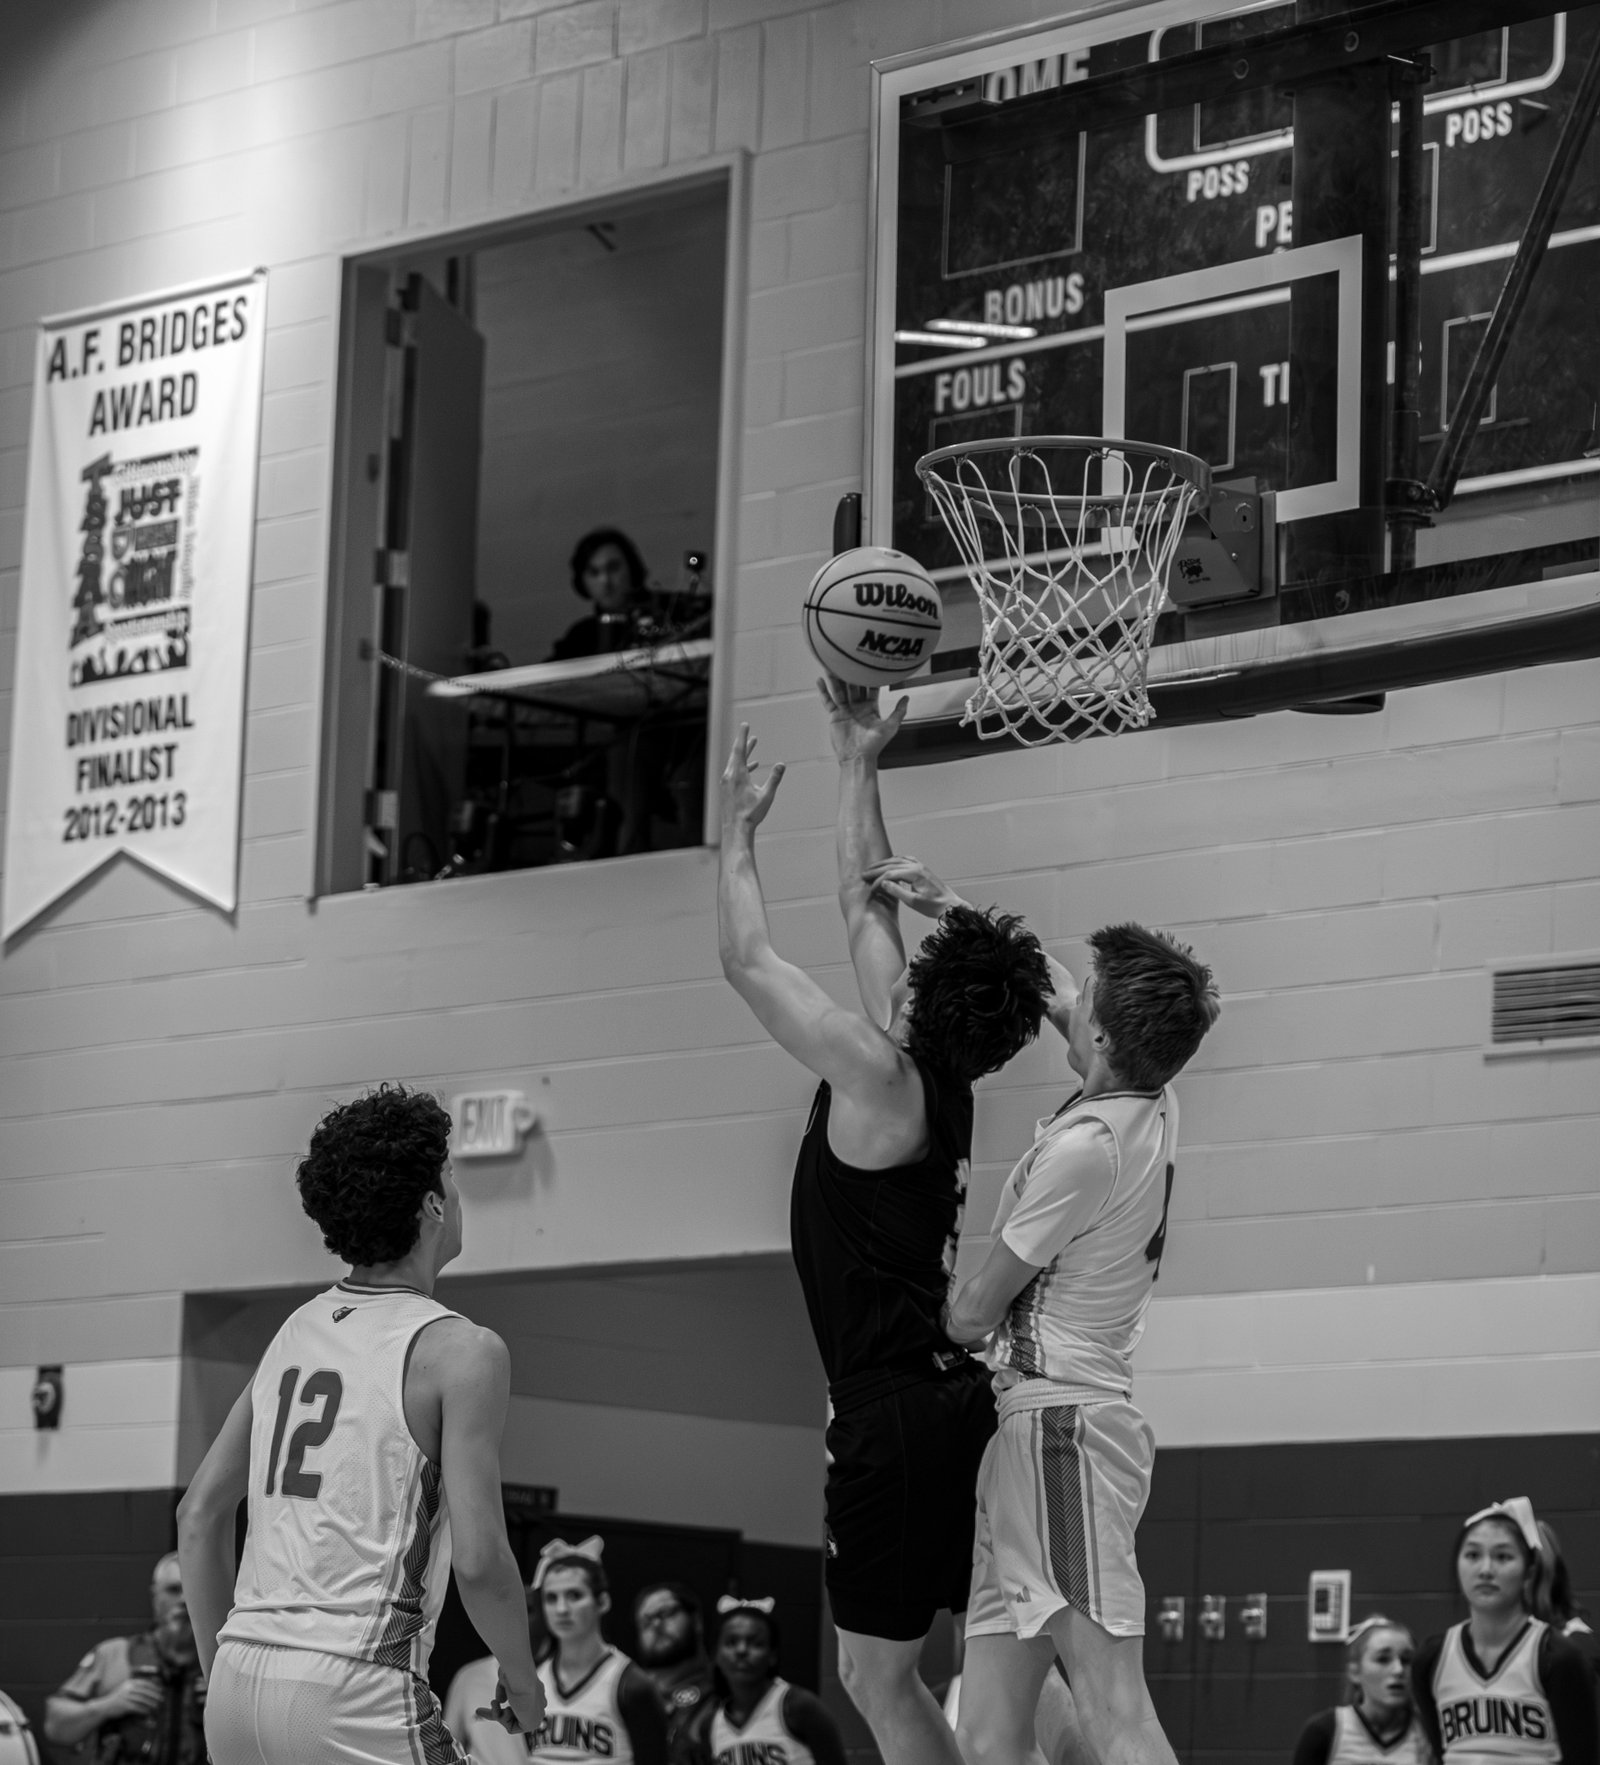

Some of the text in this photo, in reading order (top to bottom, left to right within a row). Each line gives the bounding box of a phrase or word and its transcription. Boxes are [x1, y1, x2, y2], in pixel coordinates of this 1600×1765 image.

[986, 47, 1091, 103] OME
[1446, 101, 1513, 147] POSS
[1186, 160, 1250, 202] POSS
[984, 272, 1085, 325] BONUS
[47, 295, 249, 383] A.F. BRIDGES
[88, 371, 199, 437] AWARD
[935, 358, 1027, 413] FOULS
[853, 582, 939, 620] Wilson
[857, 629, 926, 658] NCAA
[66, 693, 196, 749] DIVISIONAL
[76, 743, 179, 795] FINALIST
[62, 790, 188, 844] 2012-2013
[264, 1364, 344, 1501] 12
[1442, 1697, 1546, 1743] BRUINS
